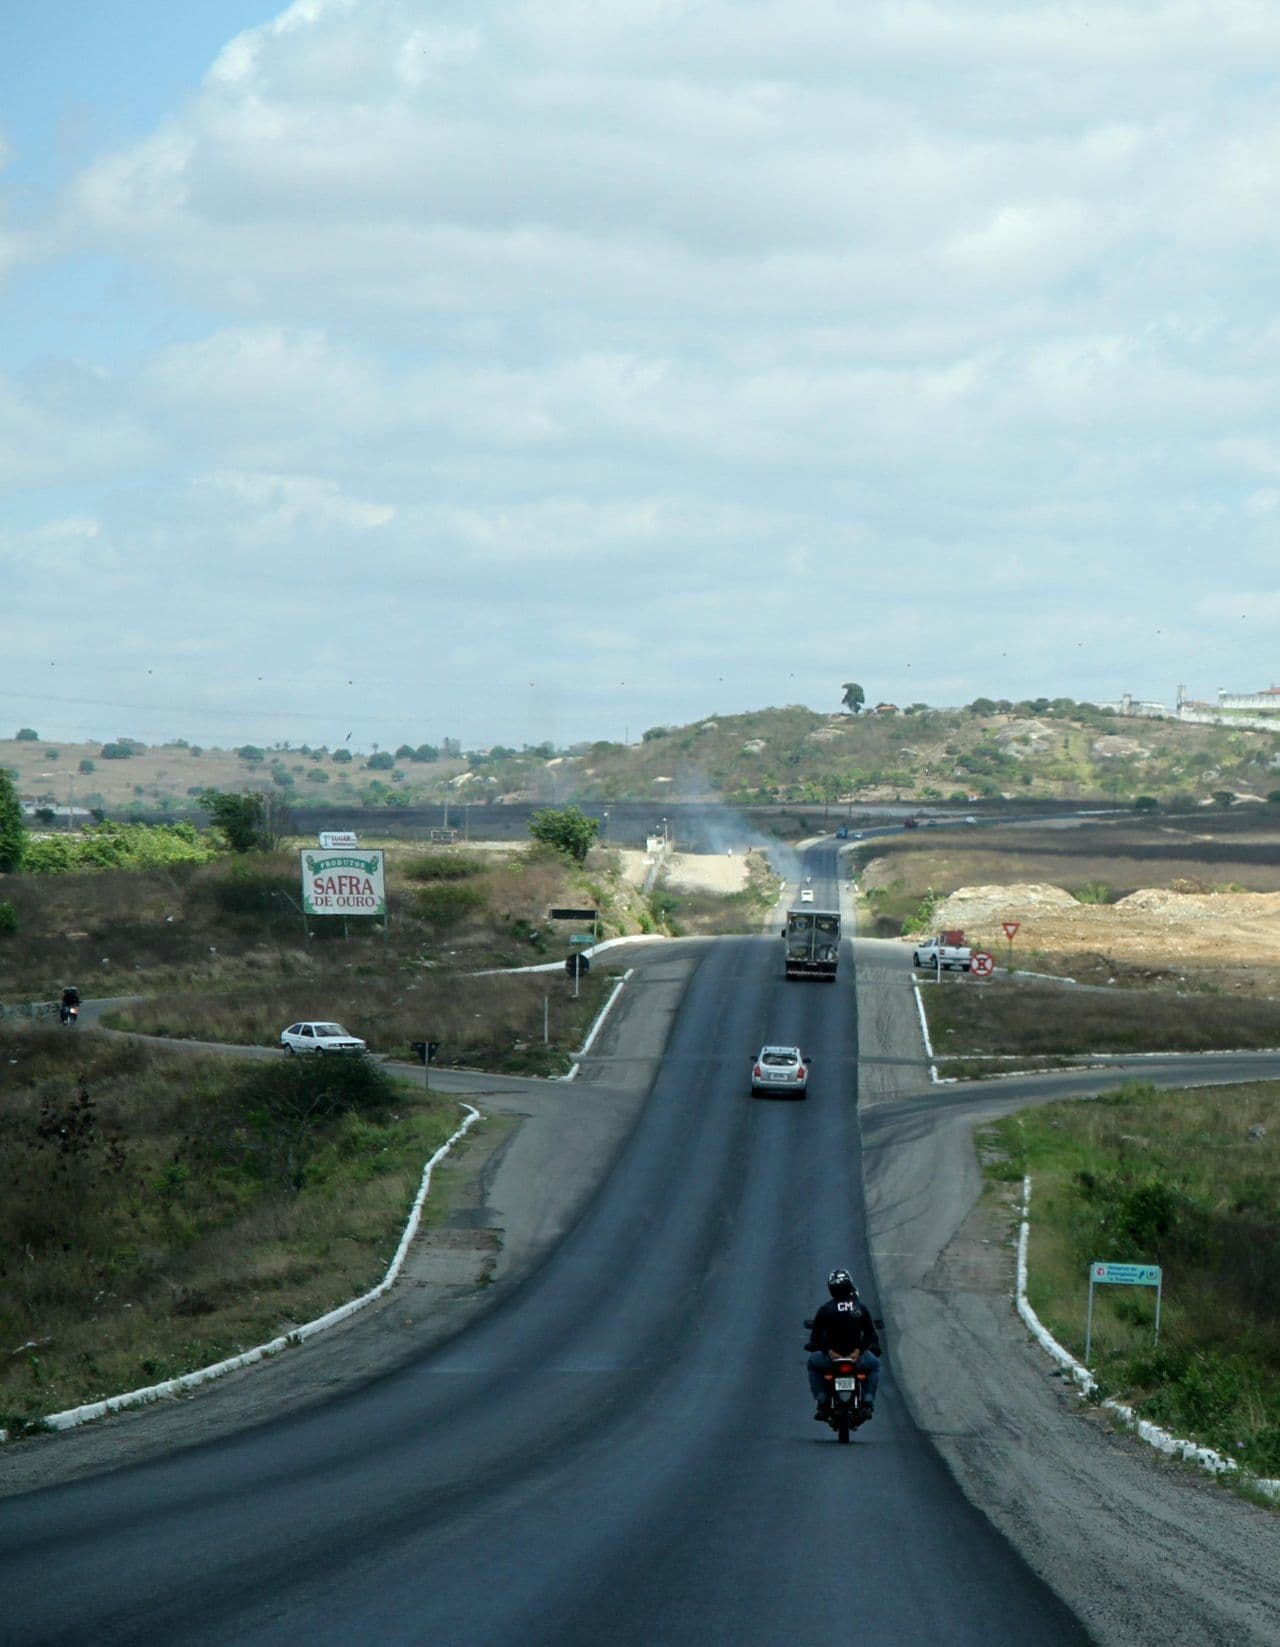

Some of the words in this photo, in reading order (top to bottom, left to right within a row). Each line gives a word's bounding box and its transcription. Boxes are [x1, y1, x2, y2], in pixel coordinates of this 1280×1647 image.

[320, 860, 366, 869] PRODUTOS
[313, 875, 374, 895] SAFRA
[314, 896, 333, 907] DE
[336, 896, 375, 907] OURO
[837, 1301, 853, 1311] CM
